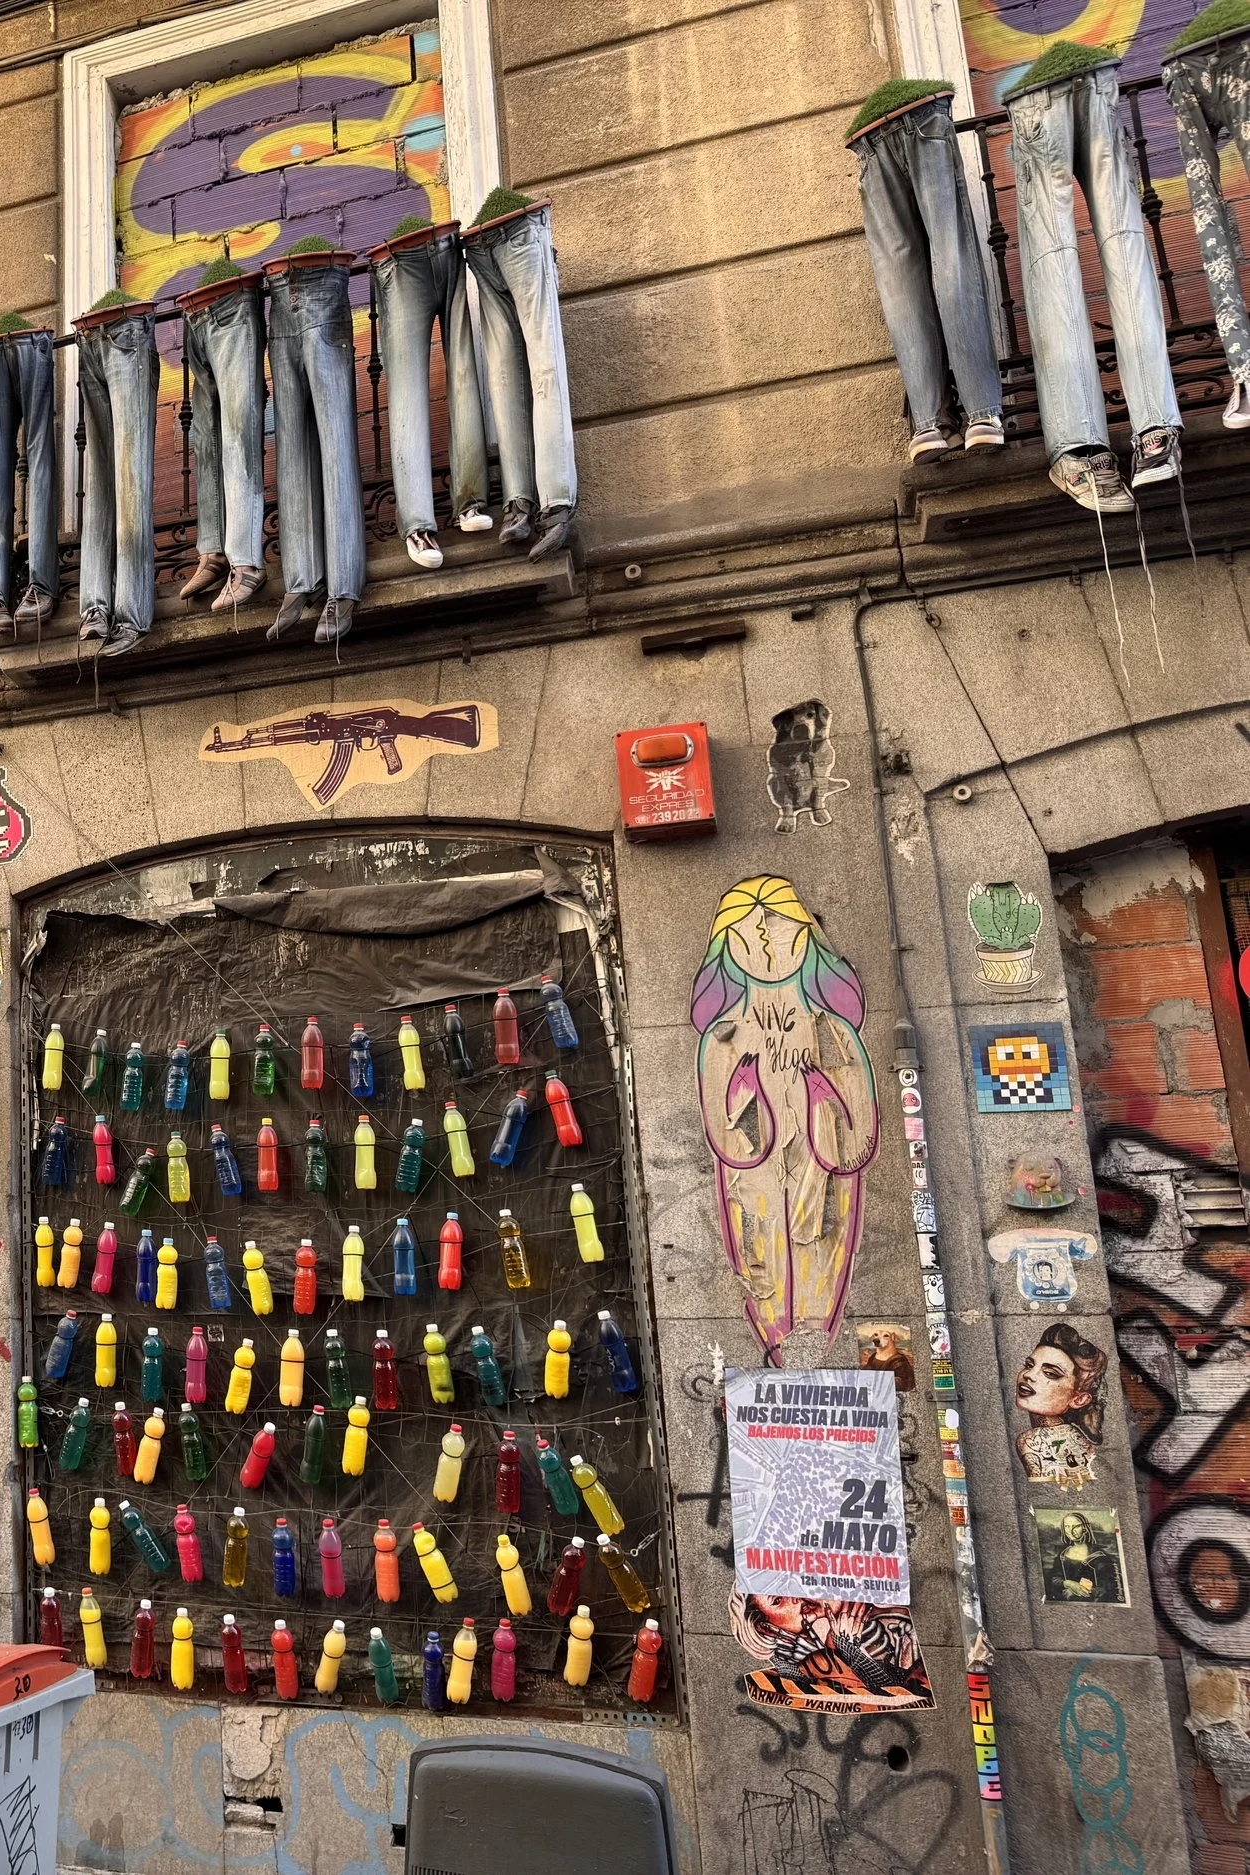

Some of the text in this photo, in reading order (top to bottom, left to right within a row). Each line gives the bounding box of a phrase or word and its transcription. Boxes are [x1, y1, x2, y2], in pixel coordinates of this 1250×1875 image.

[628, 788, 705, 805] SEGURIDAD
[652, 810, 671, 823] 239
[672, 809, 686, 820] 20
[754, 1383, 869, 1407] LA VIVIENDA
[736, 1406, 889, 1429] NOS CUESTA LA VIDA
[747, 1425, 877, 1443] BAJEMOS LOS PRECIOS
[839, 1478, 889, 1520] 24
[800, 1521, 898, 1553] de MAYO
[745, 1547, 900, 1580] MANIFESTACIÓN
[800, 1575, 901, 1592] 12h ATOCHA SEVILLA
[805, 1698, 863, 1714] WARNING
